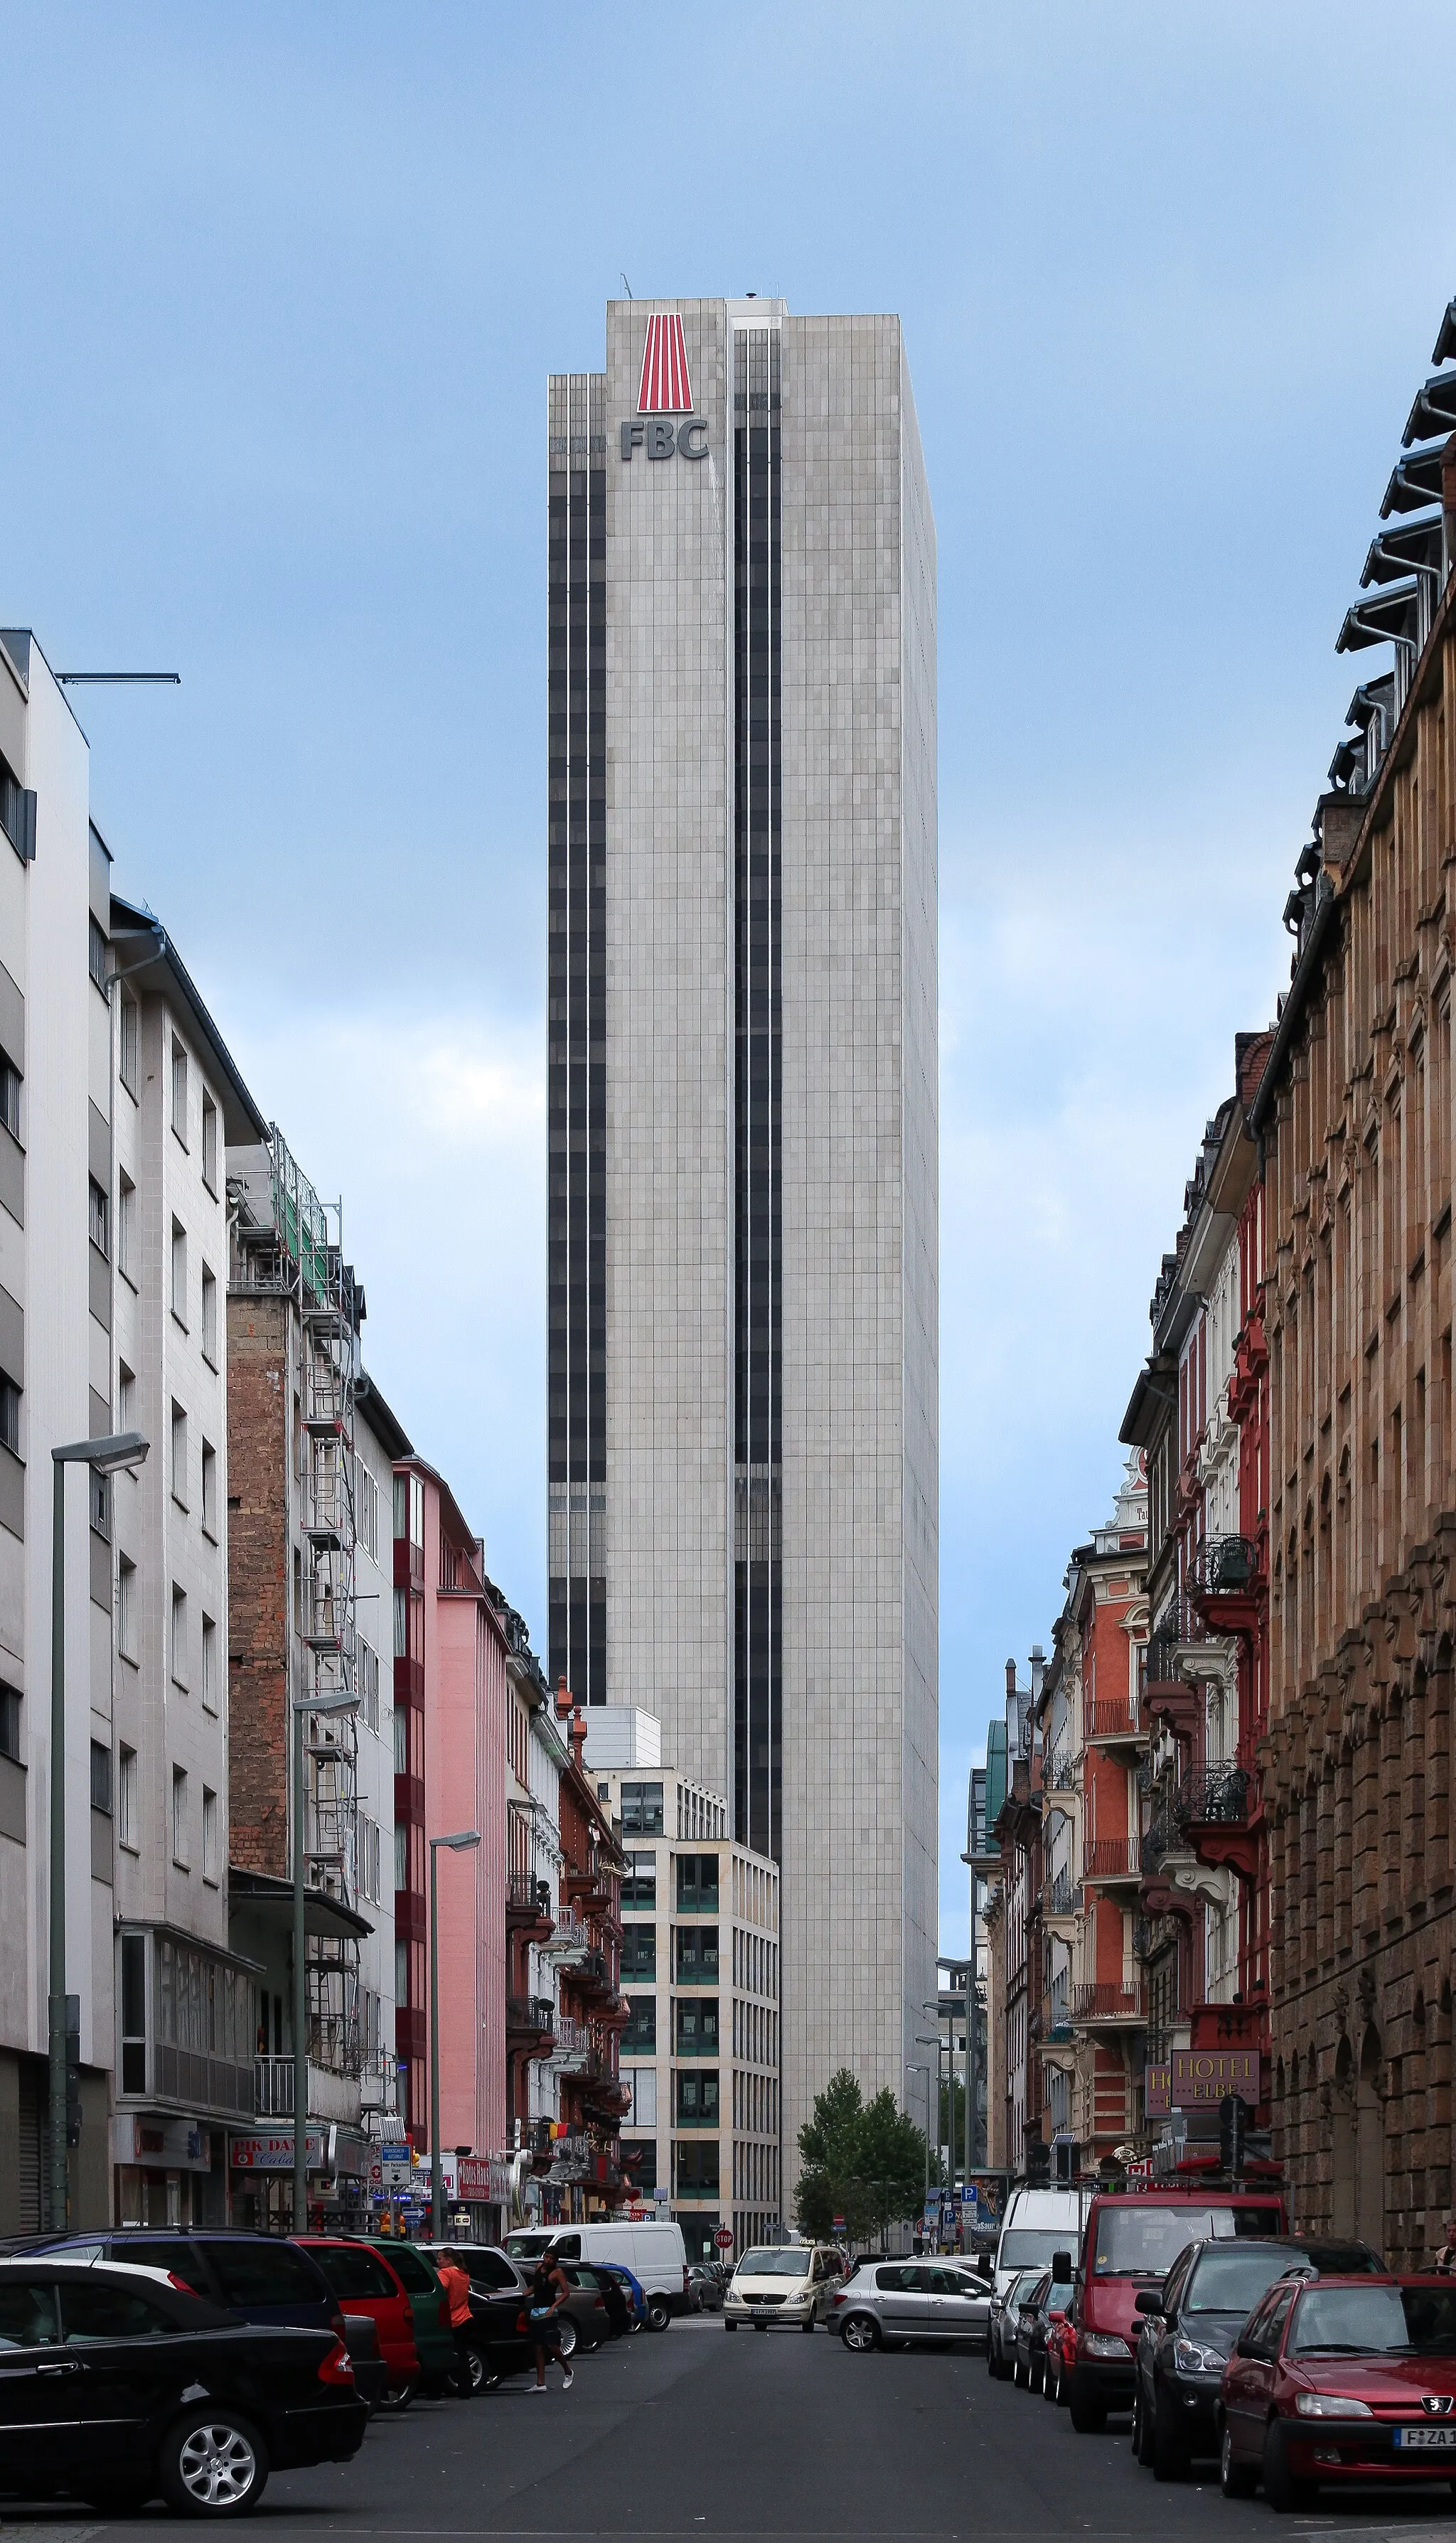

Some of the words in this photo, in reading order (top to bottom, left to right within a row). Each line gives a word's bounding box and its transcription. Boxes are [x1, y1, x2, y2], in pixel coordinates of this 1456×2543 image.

[621, 419, 709, 459] FBC
[1178, 2057, 1255, 2078] HOTEL
[233, 2138, 315, 2152] PIK-DAE
[477, 2162, 489, 2185] Haus
